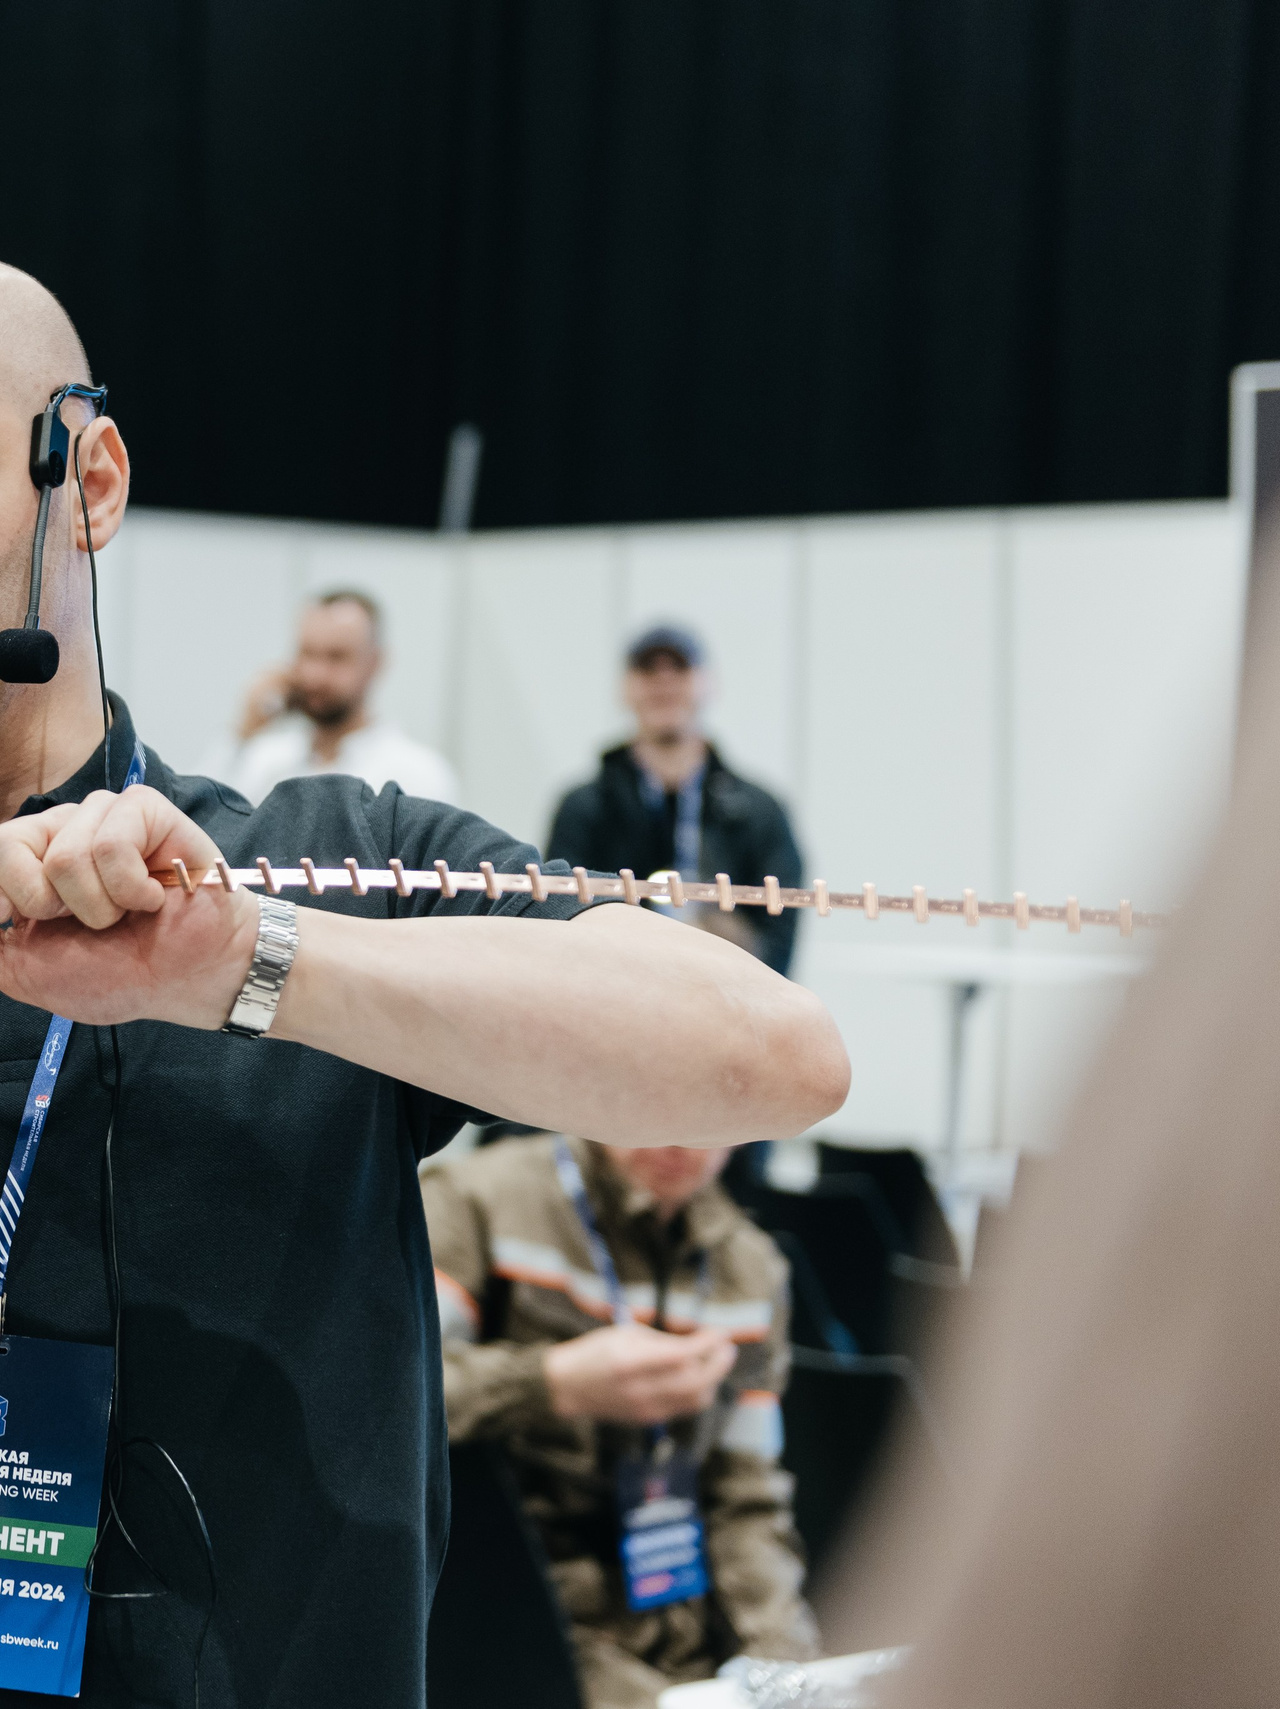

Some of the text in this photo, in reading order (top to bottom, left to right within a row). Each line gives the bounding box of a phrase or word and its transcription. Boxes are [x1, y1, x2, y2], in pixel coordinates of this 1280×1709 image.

[33, 1110, 45, 1143] СИБИРСКАЯ
[20, 1109, 40, 1172] СТРОИТЕЛЬНАЯ НЕДЕЛЯ
[12, 1467, 72, 1486] НЕДЕЛЯ
[22, 1487, 59, 1502] WEEK
[18, 1581, 65, 1602] 2024
[0, 1633, 59, 1650] sbweek.ru
